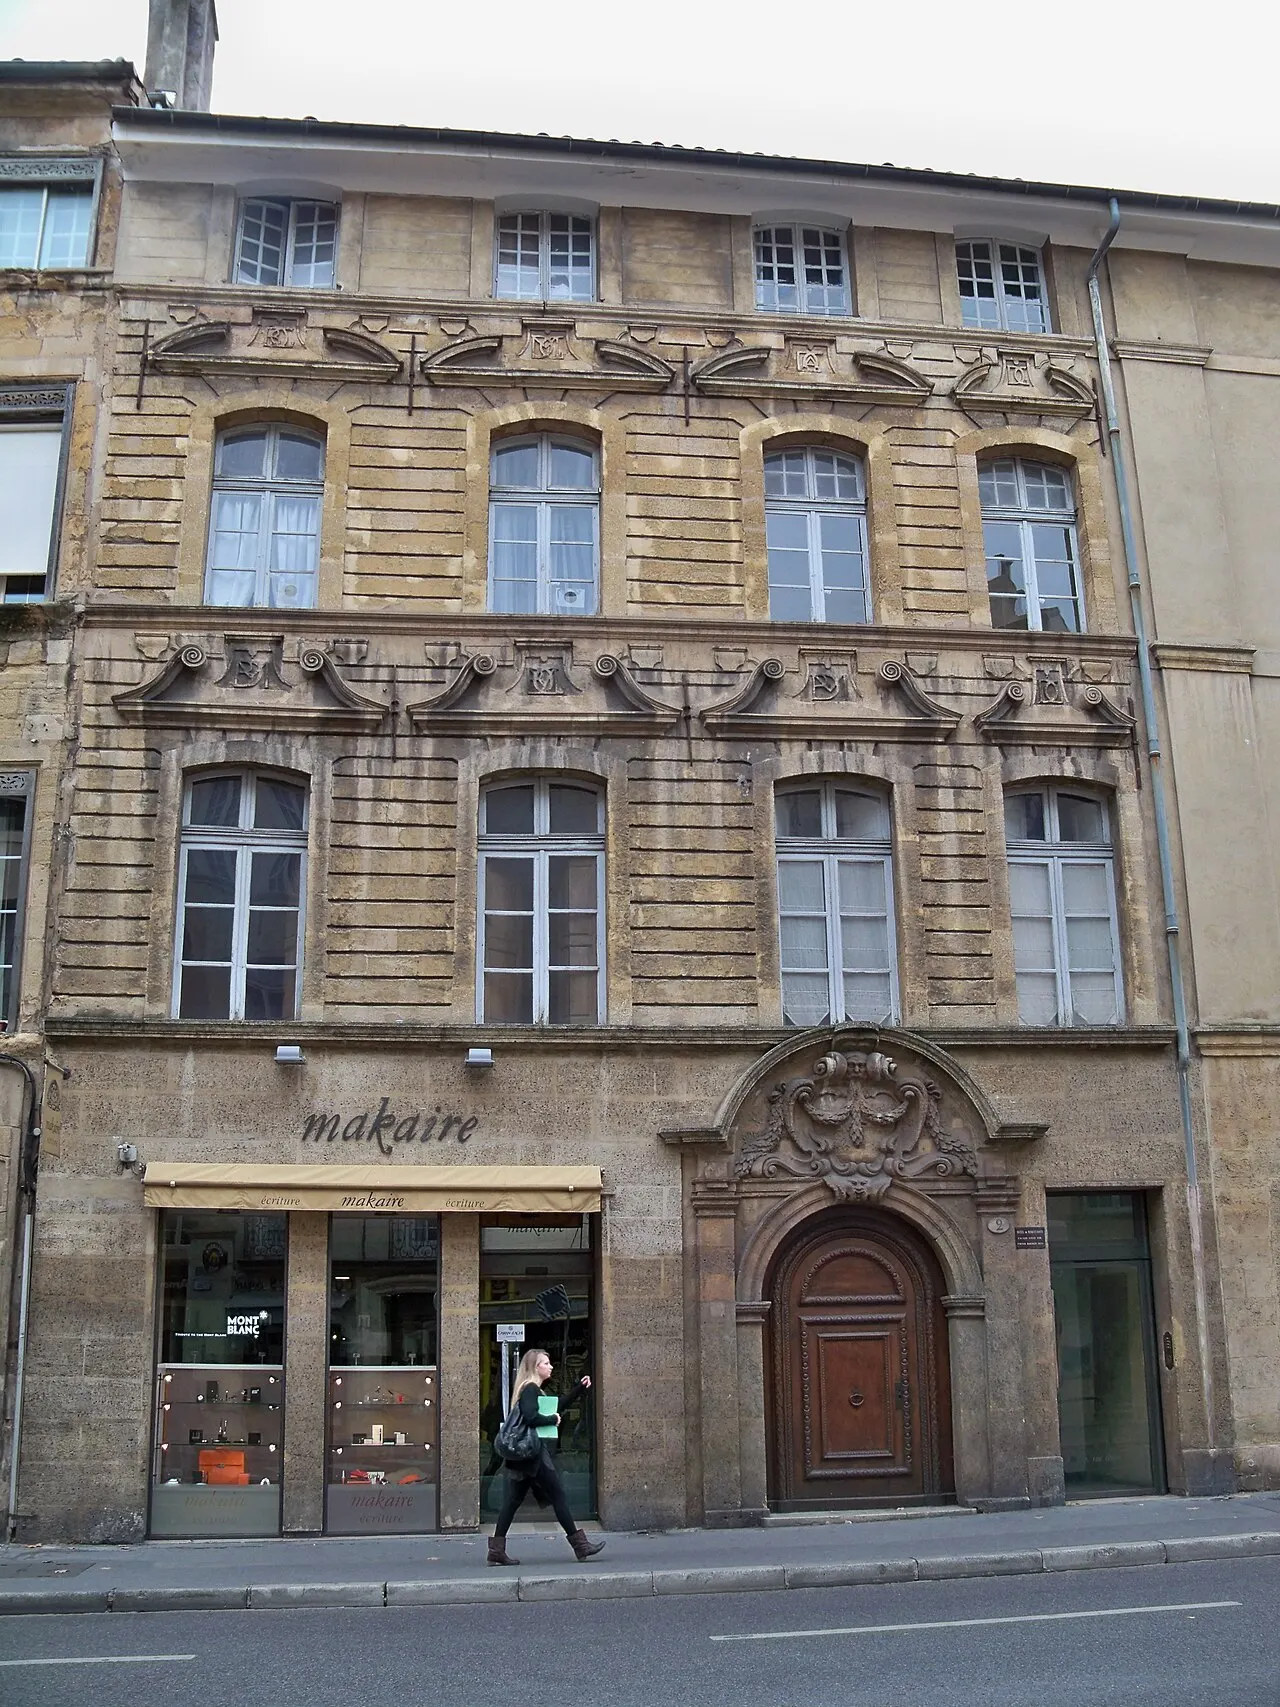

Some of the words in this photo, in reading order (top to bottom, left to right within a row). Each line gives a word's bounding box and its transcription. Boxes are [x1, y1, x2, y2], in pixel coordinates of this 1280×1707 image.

[301, 1096, 479, 1155] makaire
[260, 1194, 301, 1206] écriture
[341, 1191, 405, 1209] makaire
[445, 1197, 485, 1208] écriture
[995, 1219, 1004, 1231] 2
[227, 1316, 260, 1325] MONT
[226, 1325, 260, 1335] BLANC
[351, 1489, 414, 1510] makaire
